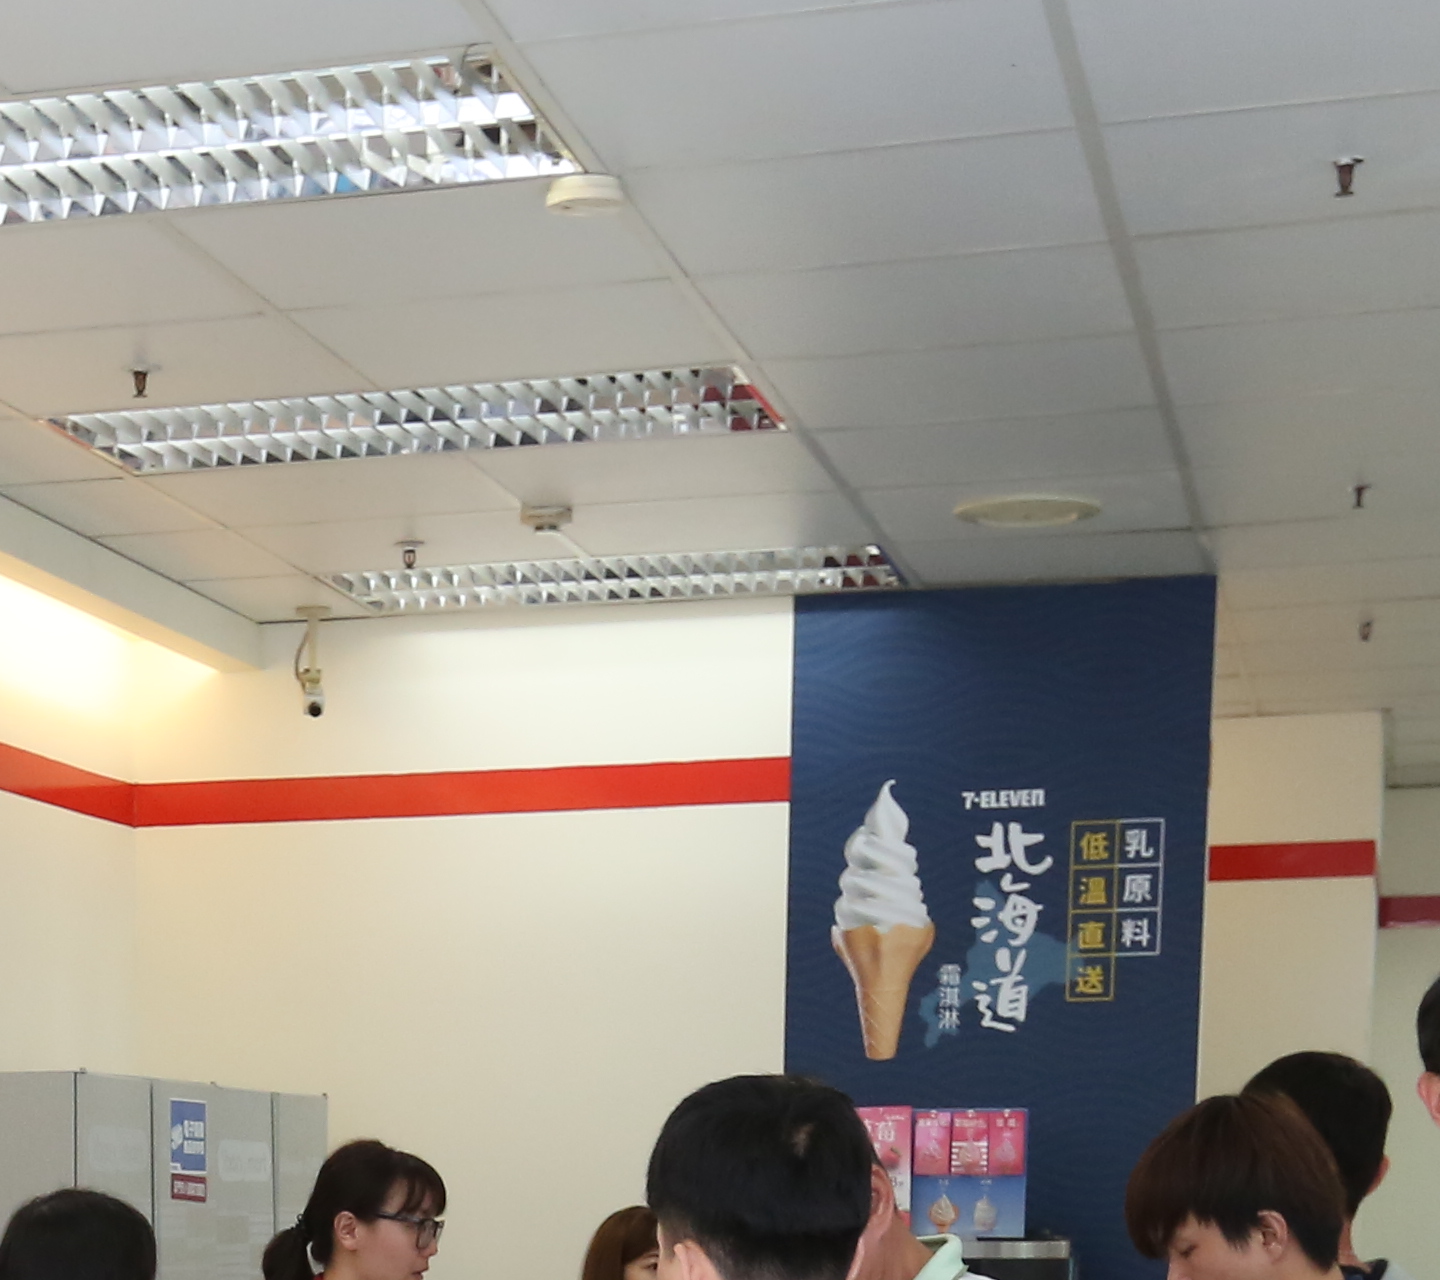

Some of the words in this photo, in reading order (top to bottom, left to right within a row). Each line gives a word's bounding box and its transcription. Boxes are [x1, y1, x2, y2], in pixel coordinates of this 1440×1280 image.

[970, 822, 1053, 1031] 北海道
[1077, 831, 1110, 996] 低溫直送
[1121, 826, 1154, 947] 乳原料
